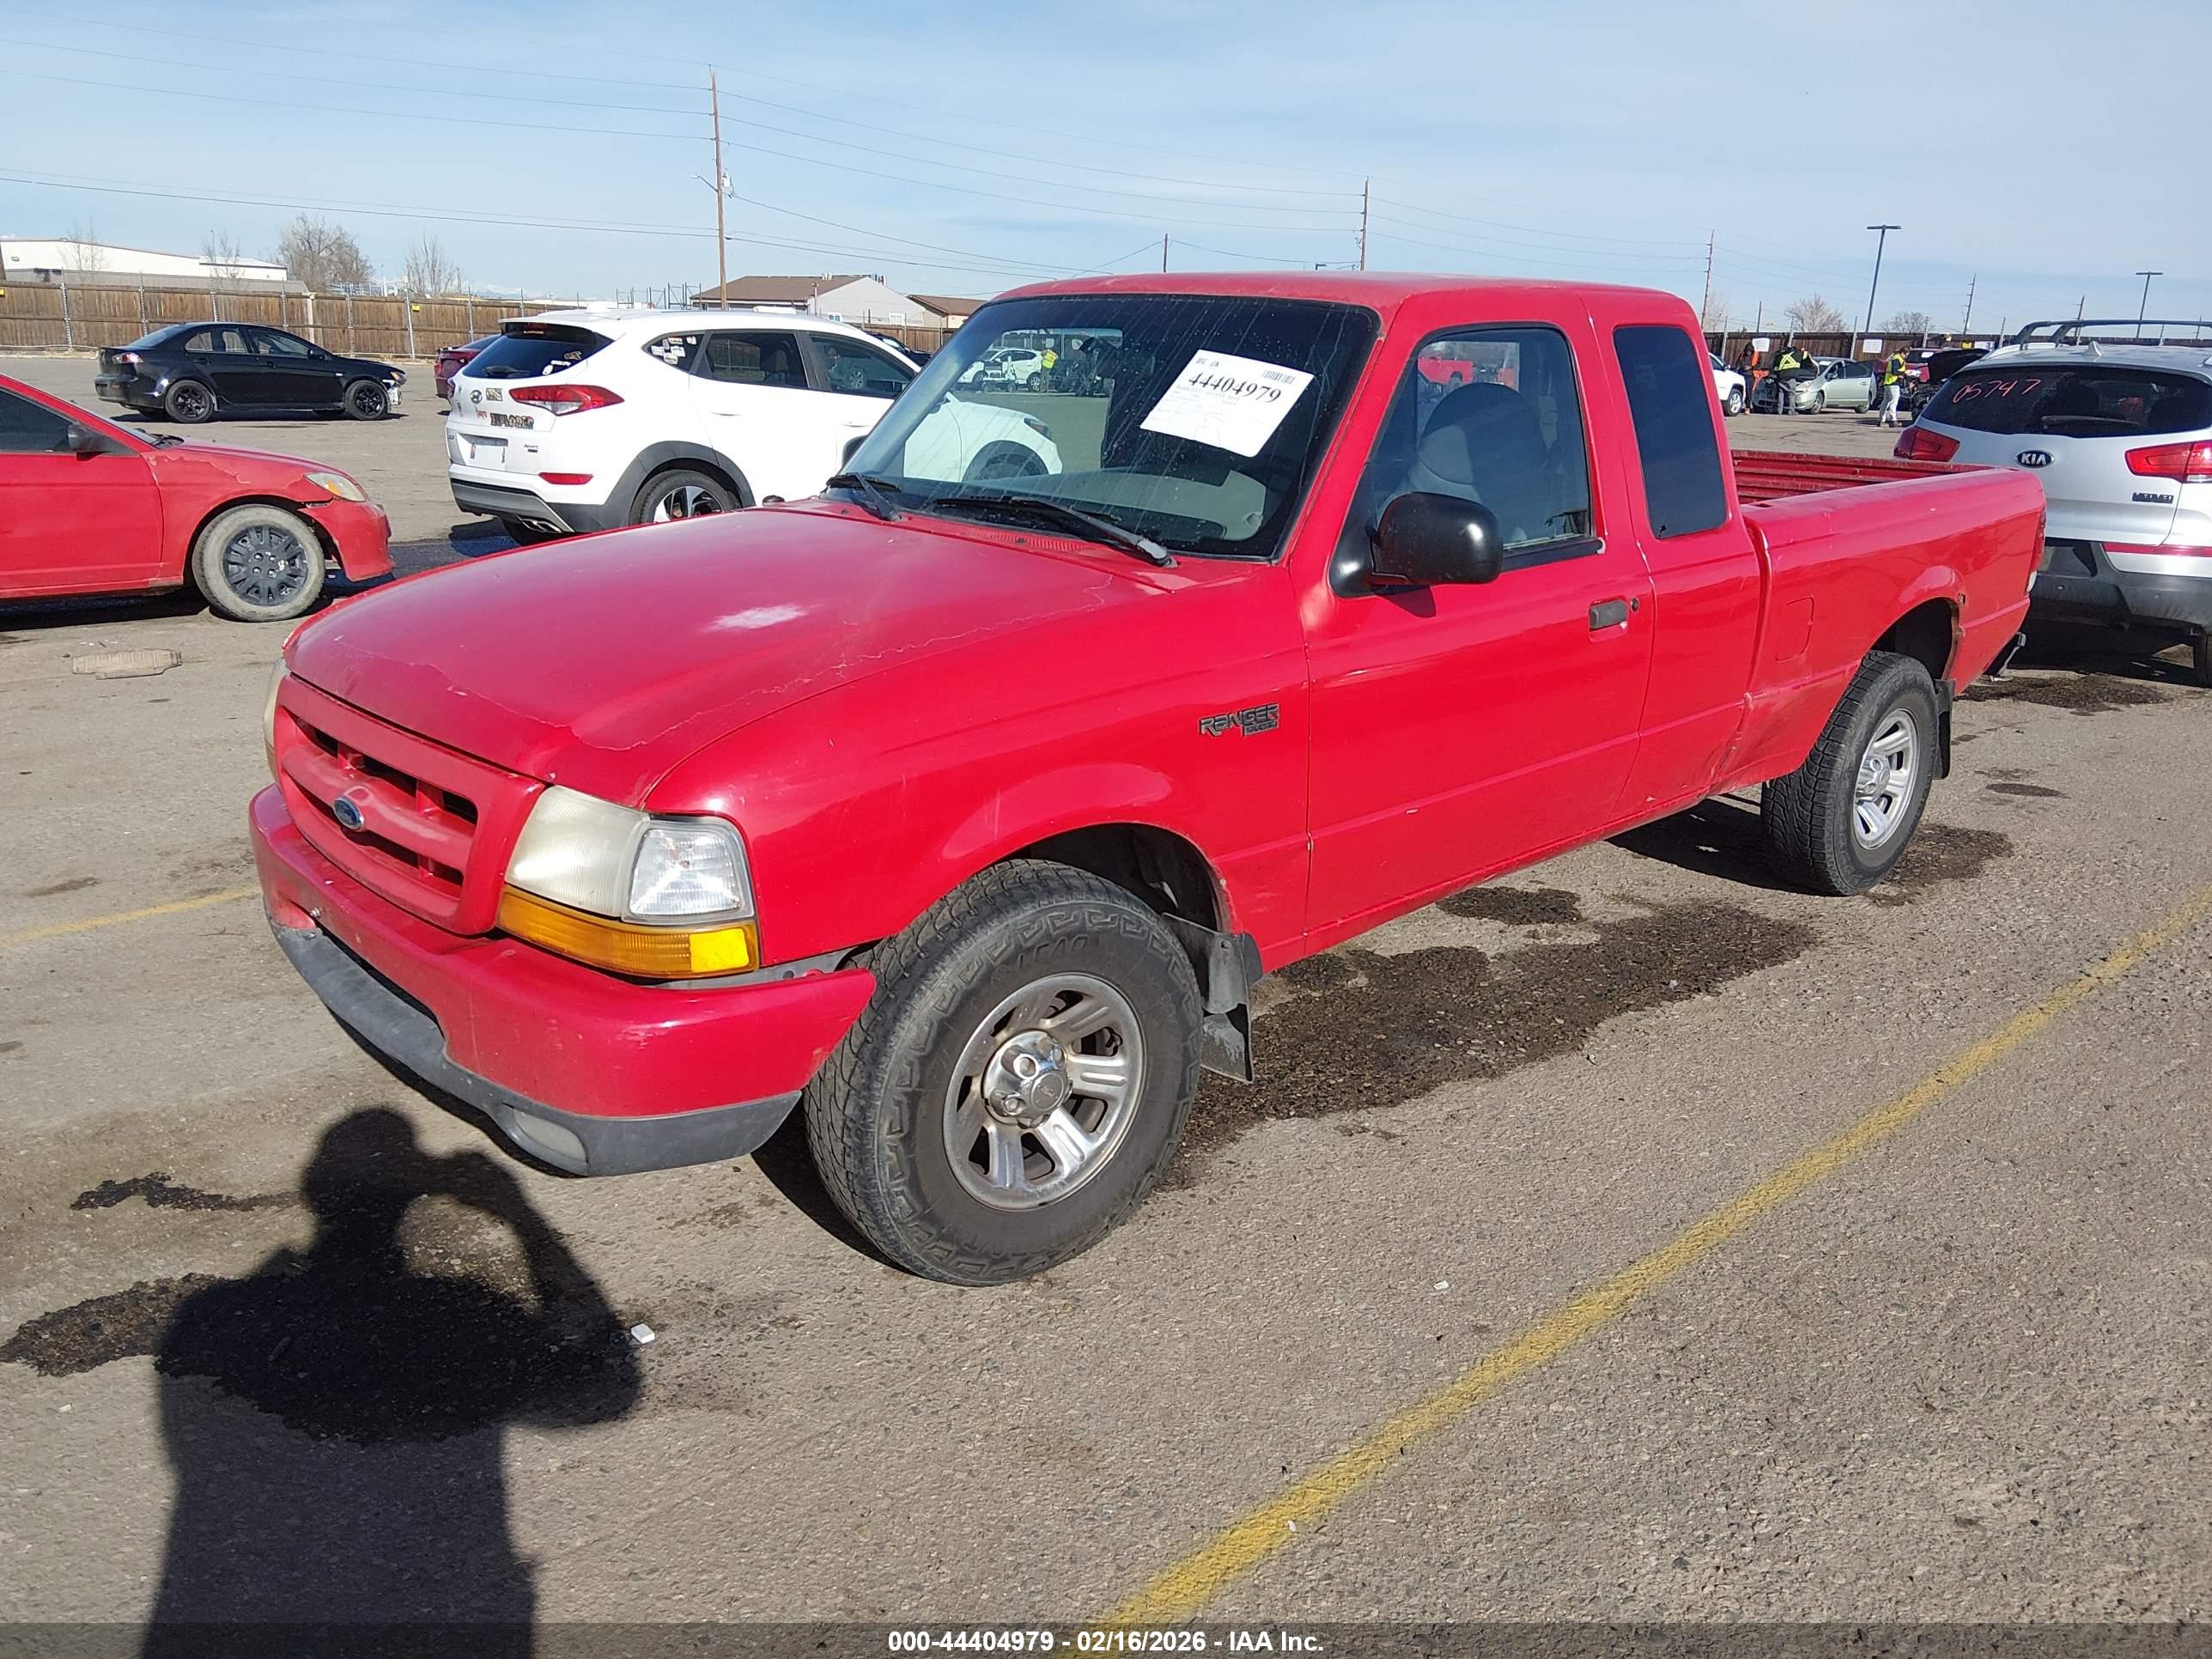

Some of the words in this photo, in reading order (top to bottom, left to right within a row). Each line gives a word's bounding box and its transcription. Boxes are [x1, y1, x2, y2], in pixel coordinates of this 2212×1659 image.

[1188, 372, 1282, 404] 44404979
[2021, 453, 2047, 465] KIA
[1198, 702, 1279, 738] RANGER
